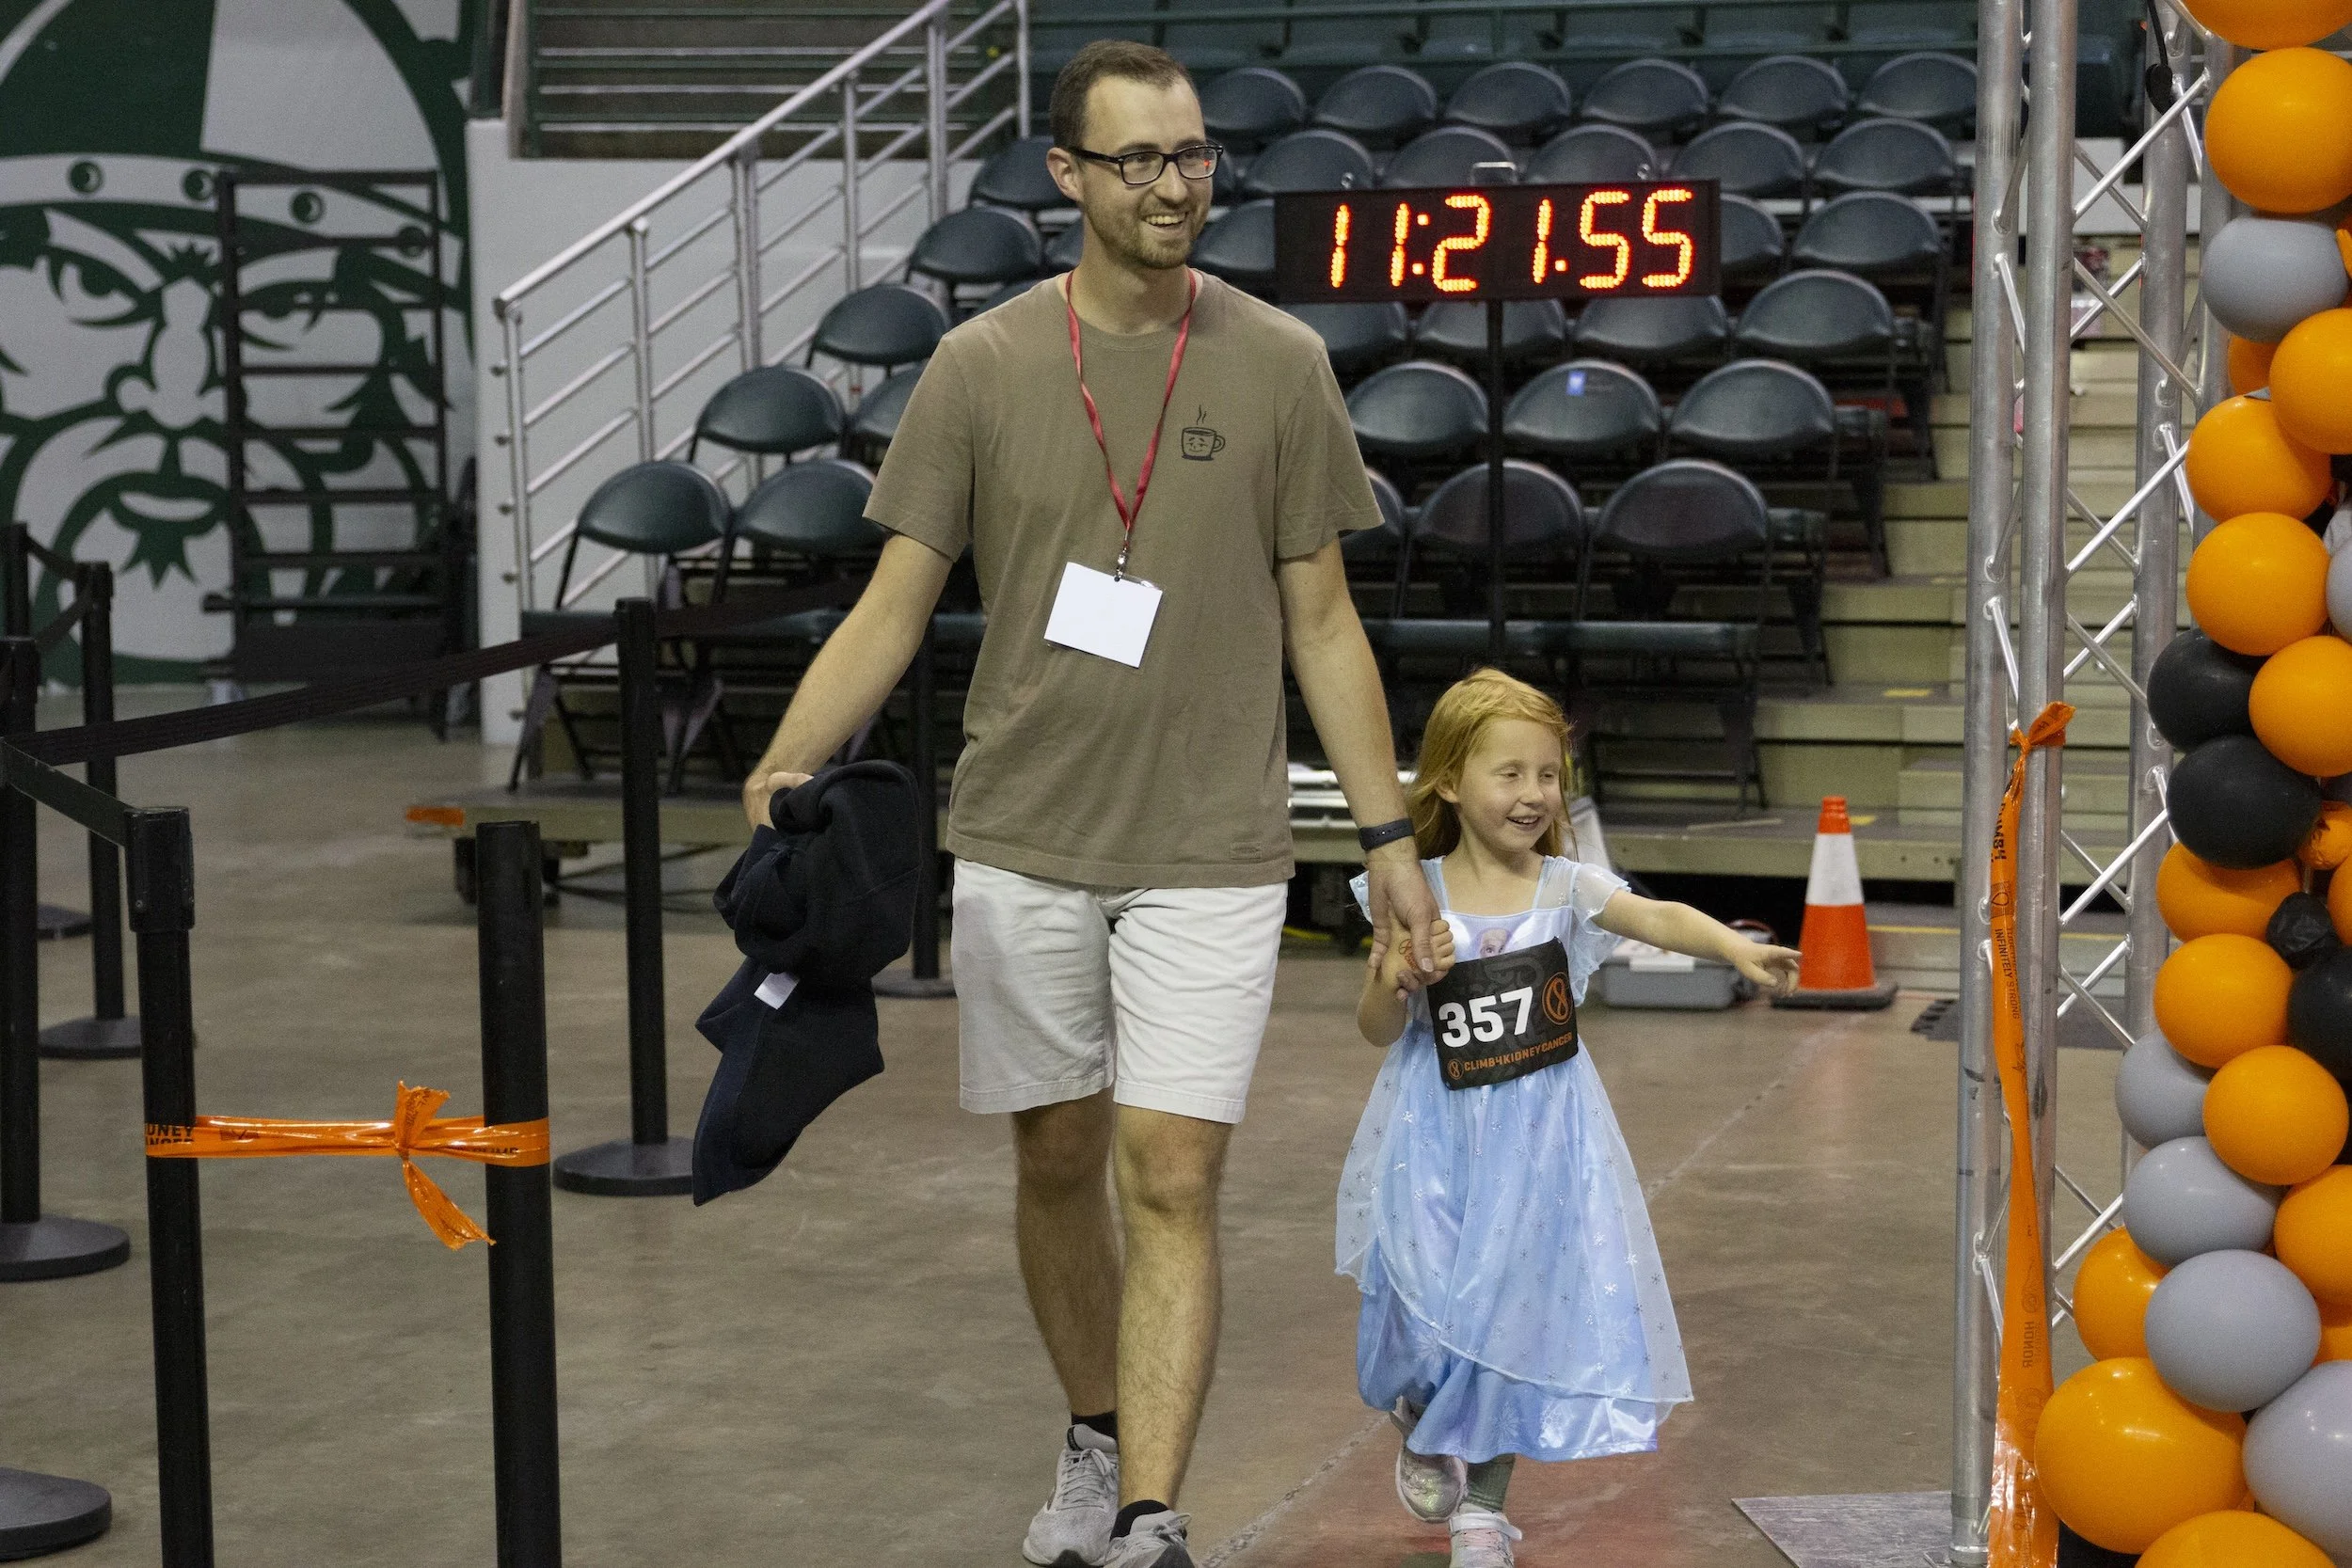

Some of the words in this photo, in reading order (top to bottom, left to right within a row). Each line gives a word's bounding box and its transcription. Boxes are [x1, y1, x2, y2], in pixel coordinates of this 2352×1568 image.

[1994, 928, 2012, 978] INFINITELY
[2007, 980, 2021, 1020] STRONG
[1438, 986, 1534, 1048] 357
